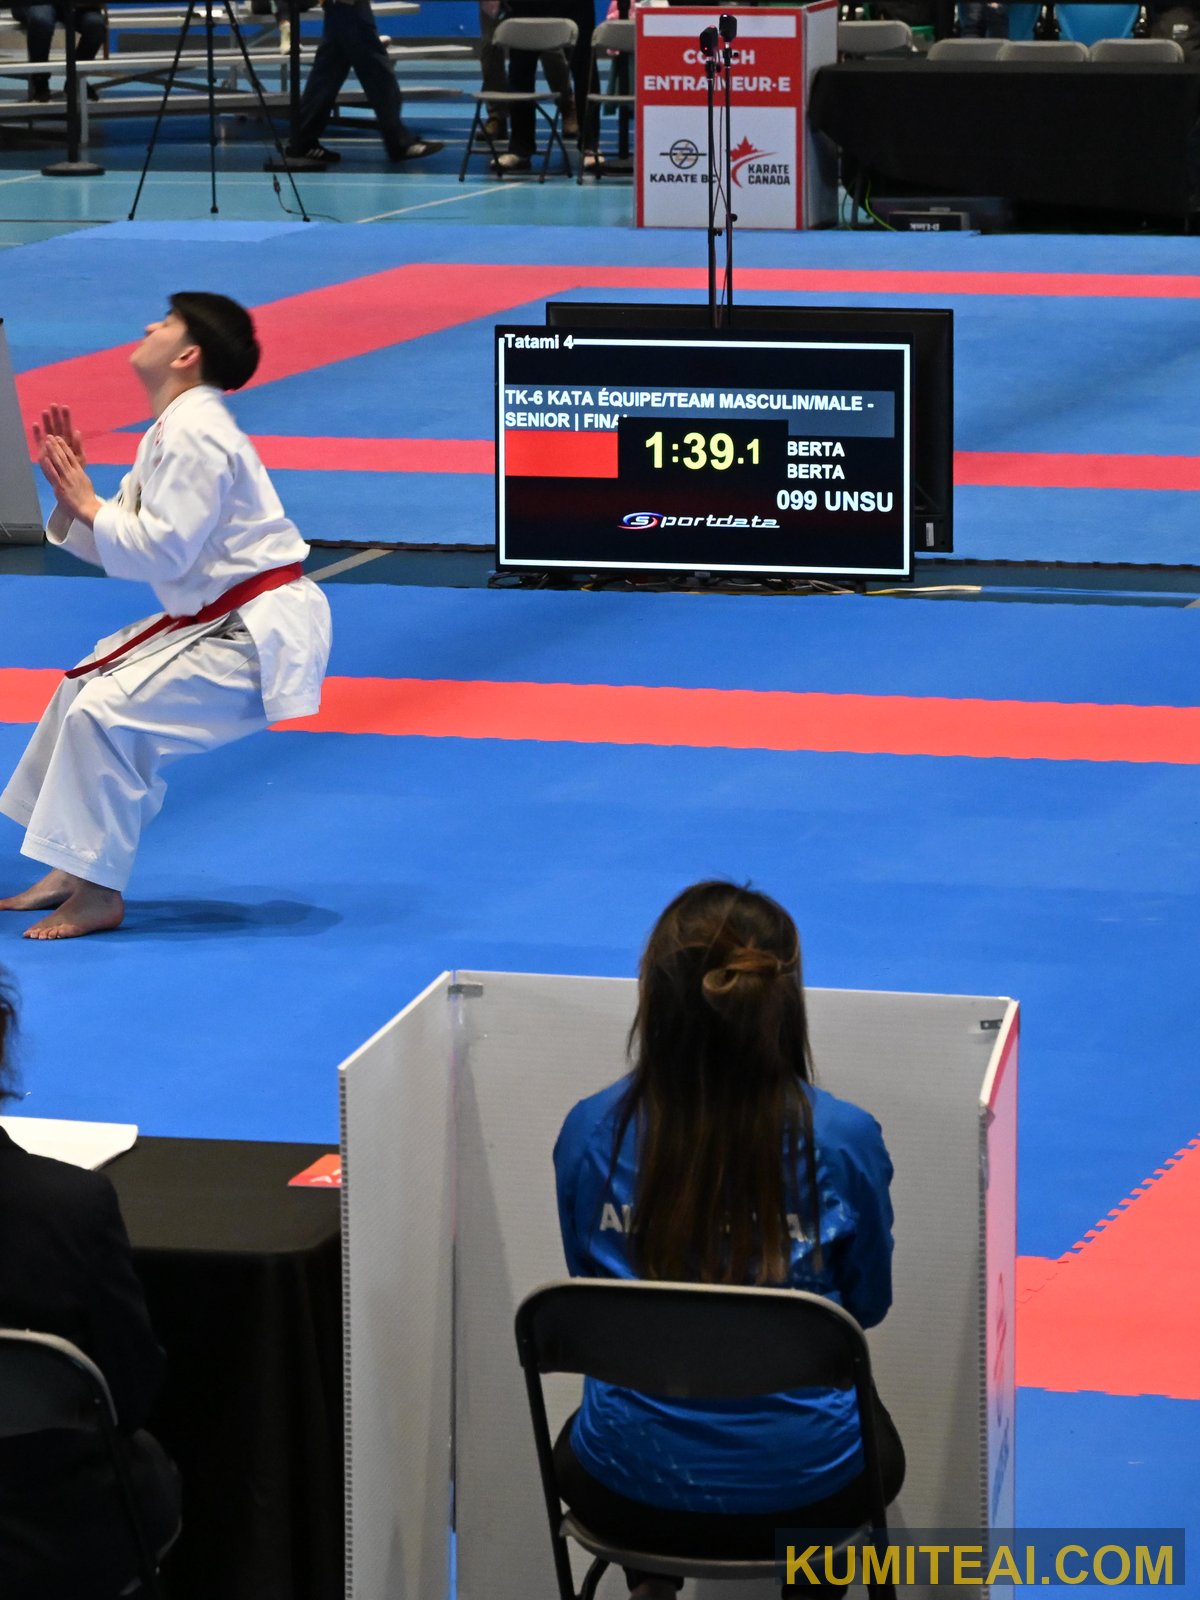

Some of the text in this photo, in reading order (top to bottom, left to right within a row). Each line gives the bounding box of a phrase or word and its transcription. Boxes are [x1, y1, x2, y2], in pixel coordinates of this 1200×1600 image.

[748, 164, 790, 175] KARATE
[650, 173, 698, 183] KARATE
[748, 175, 791, 186] CANADA
[505, 334, 574, 349] Tatami 4
[505, 389, 543, 405] TK-6
[548, 390, 594, 406] KATA
[599, 388, 715, 408] ÉQUIPE/TEAM
[719, 393, 863, 411] MASCULIN/MALE
[505, 412, 570, 428] SENIOR
[584, 413, 627, 429] FINA
[645, 431, 760, 470] 1:39.1
[787, 441, 846, 457] BERTA
[787, 463, 846, 480] BERTA
[776, 489, 894, 513] 099 UNSU
